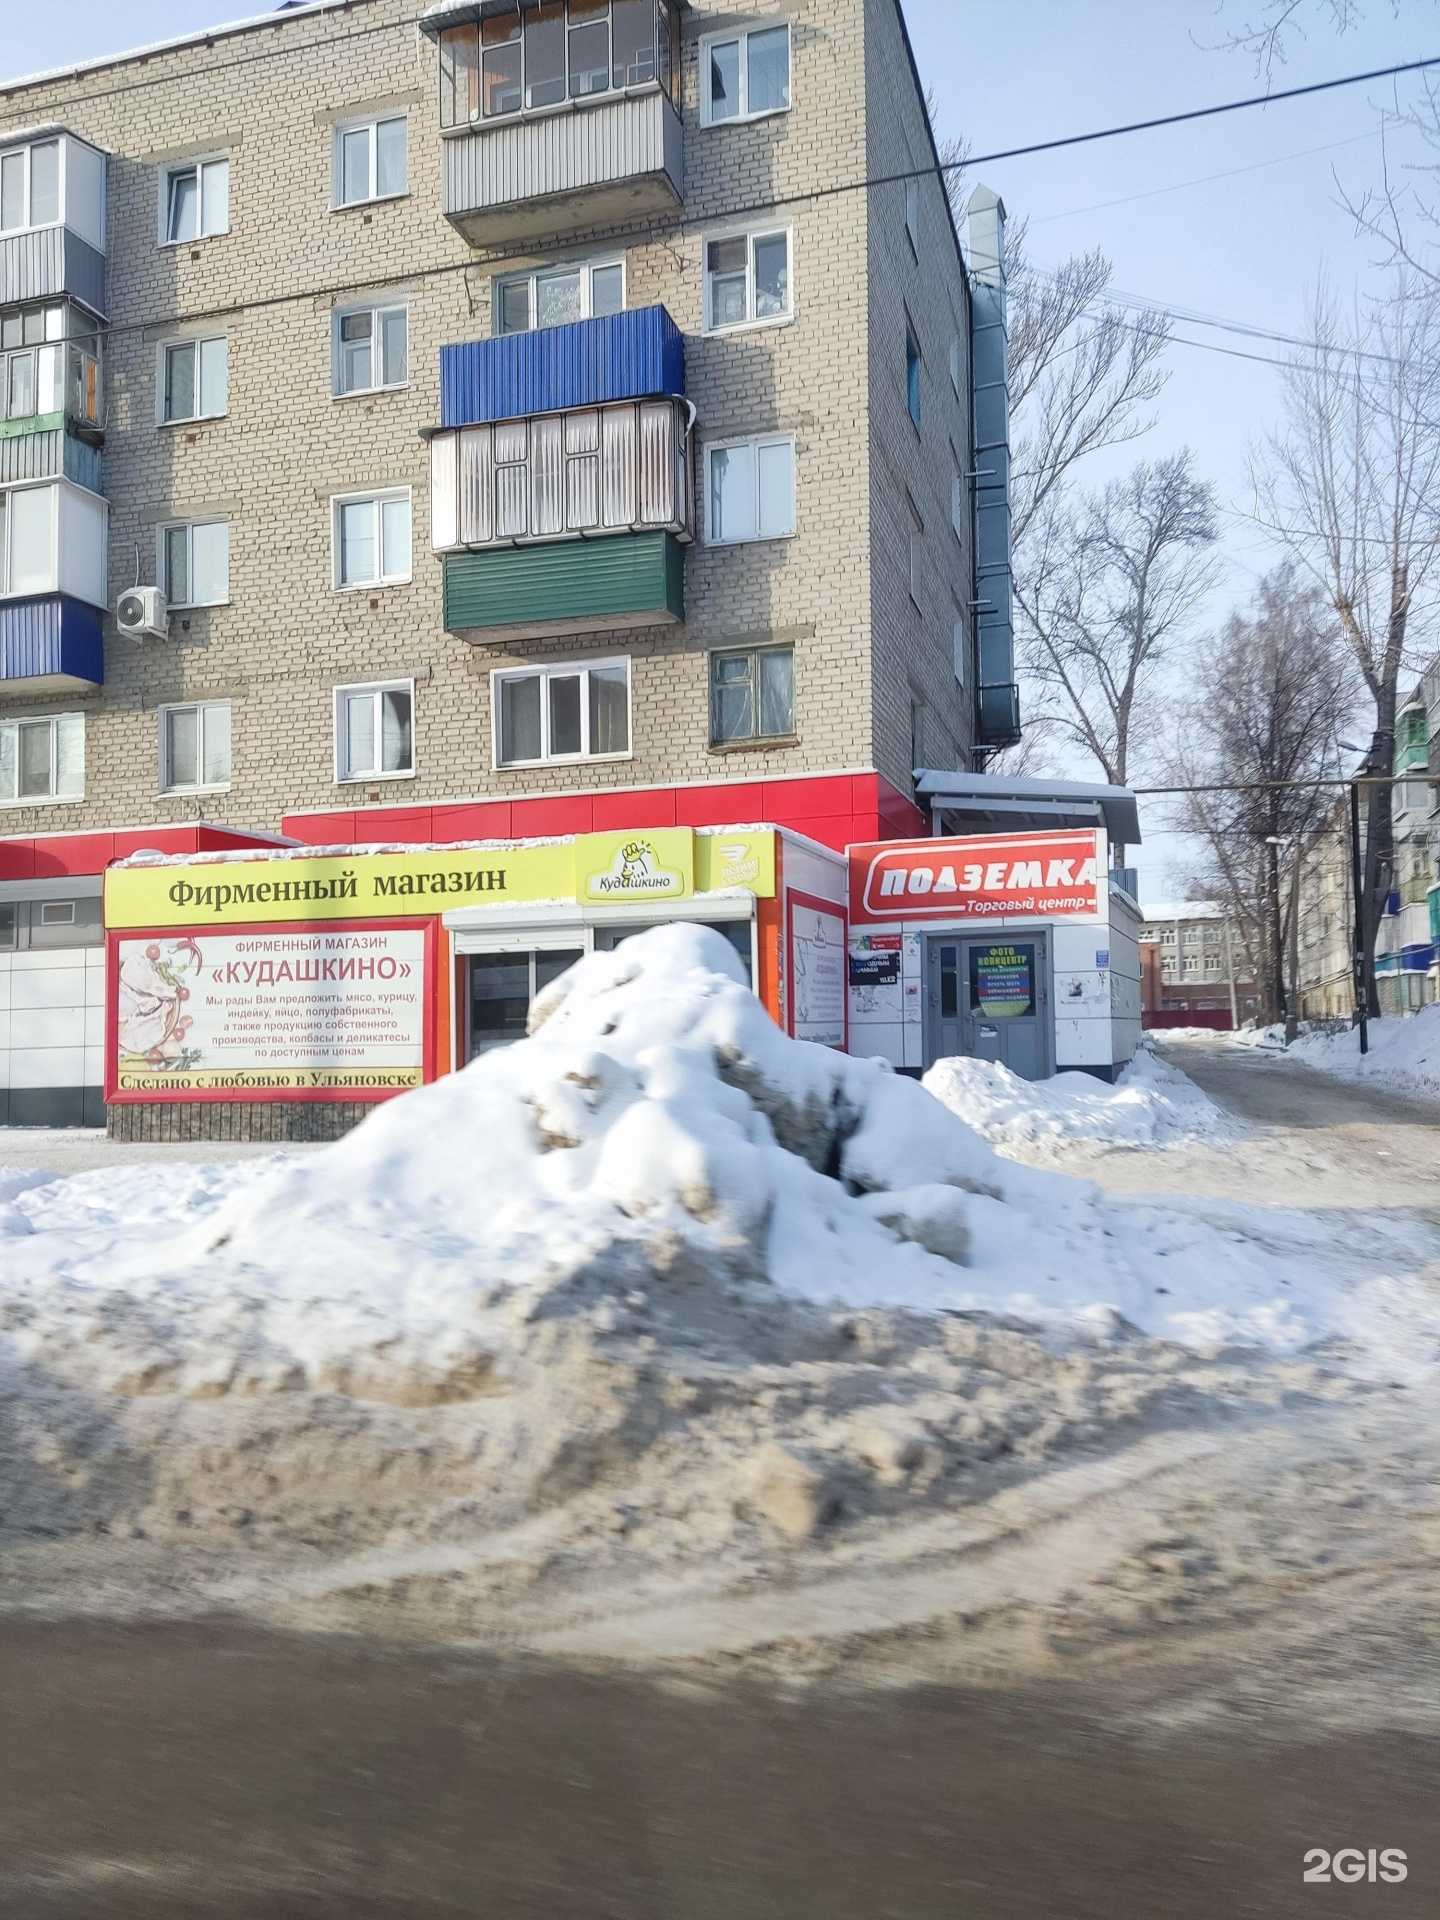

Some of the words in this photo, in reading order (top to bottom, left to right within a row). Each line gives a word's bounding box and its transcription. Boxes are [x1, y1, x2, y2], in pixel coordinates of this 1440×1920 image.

[600, 876, 670, 892] Кудашкино
[880, 858, 1096, 896] ПОДЗЕМКА
[168, 870, 358, 911] Фирменный
[373, 869, 507, 896] магазин
[967, 897, 1034, 913] Торговый
[1039, 897, 1086, 911] центр
[235, 936, 321, 952] ФИРМЕННЫЙ
[325, 937, 388, 950] МАГАЗИН
[212, 957, 411, 987] «КУДАШКИНО»
[206, 996, 222, 1005] Мы
[226, 996, 252, 1008] рады
[256, 995, 276, 1004] Вам
[279, 994, 343, 1006] предложить
[346, 995, 375, 1005] мясо,
[378, 994, 417, 1005] курицу,
[228, 1008, 271, 1019] индейку,
[306, 1006, 393, 1018] полуфабрикаты,
[233, 1023, 261, 1031] также
[264, 1021, 322, 1033] продукцию
[325, 1019, 398, 1030] собственного
[212, 1036, 286, 1046] производства,
[289, 1034, 334, 1044] колбасы
[346, 1034, 410, 1044] деликатесы
[255, 1049, 267, 1057] по
[270, 1048, 329, 1058] доступным
[332, 1048, 365, 1057] ценам
[120, 1075, 191, 1089] Сделано
[196, 1077, 204, 1088] с
[208, 1073, 290, 1088] любовью
[297, 1076, 305, 1086] в
[311, 1071, 417, 1087] Ульяновске
